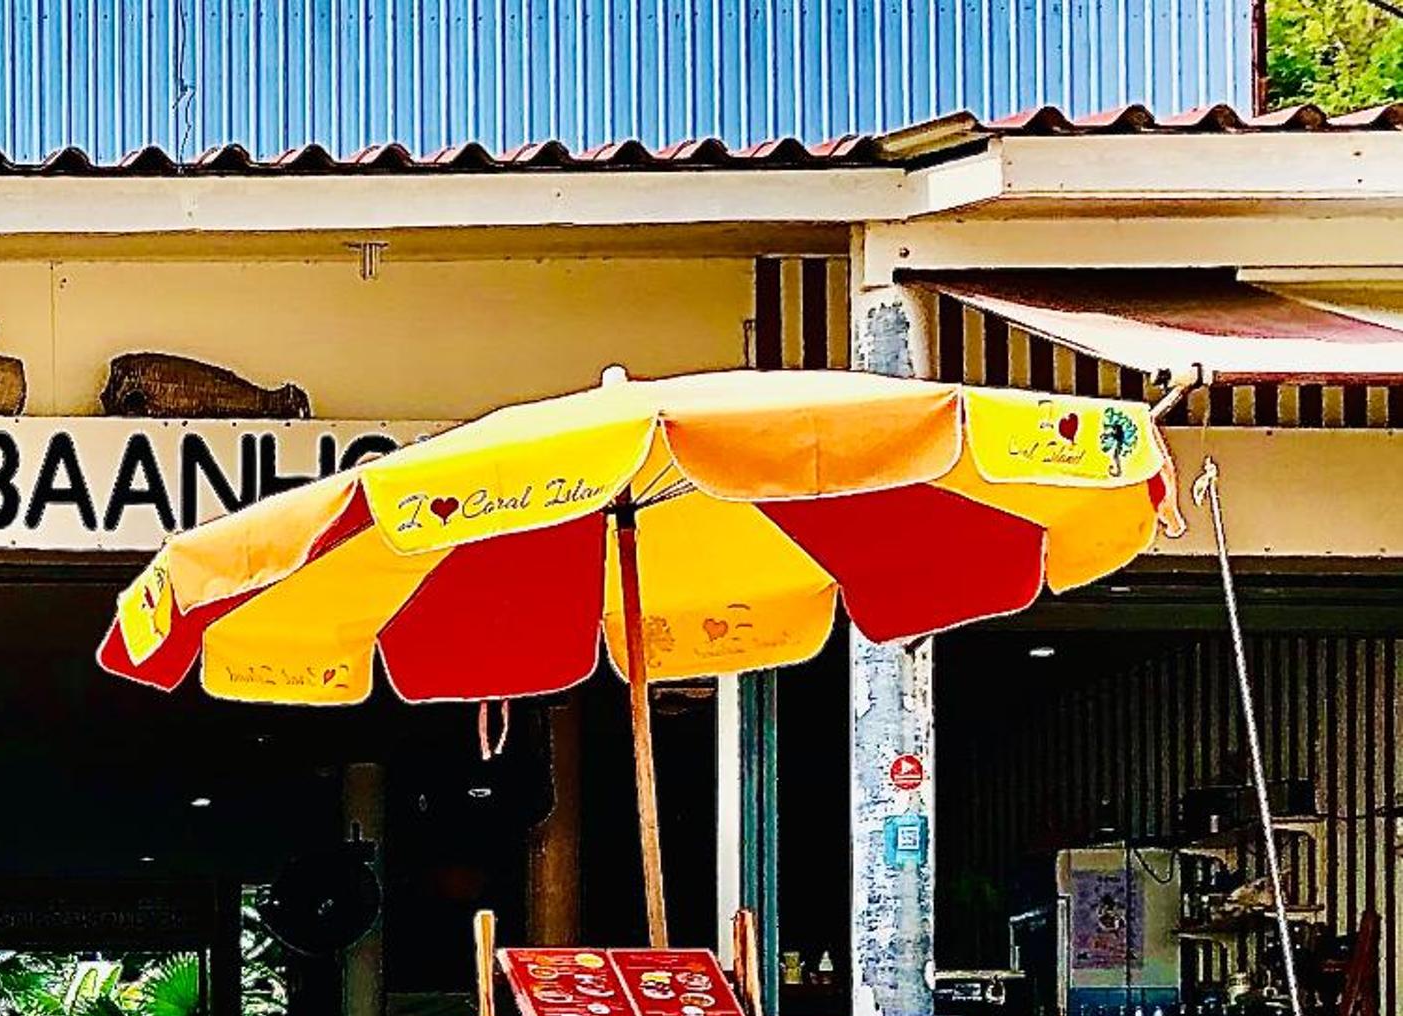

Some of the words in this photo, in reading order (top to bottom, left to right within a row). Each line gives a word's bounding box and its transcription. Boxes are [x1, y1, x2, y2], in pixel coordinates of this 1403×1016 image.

[397, 494, 429, 532] I
[461, 485, 533, 519] Coral
[543, 477, 606, 508] Islan
